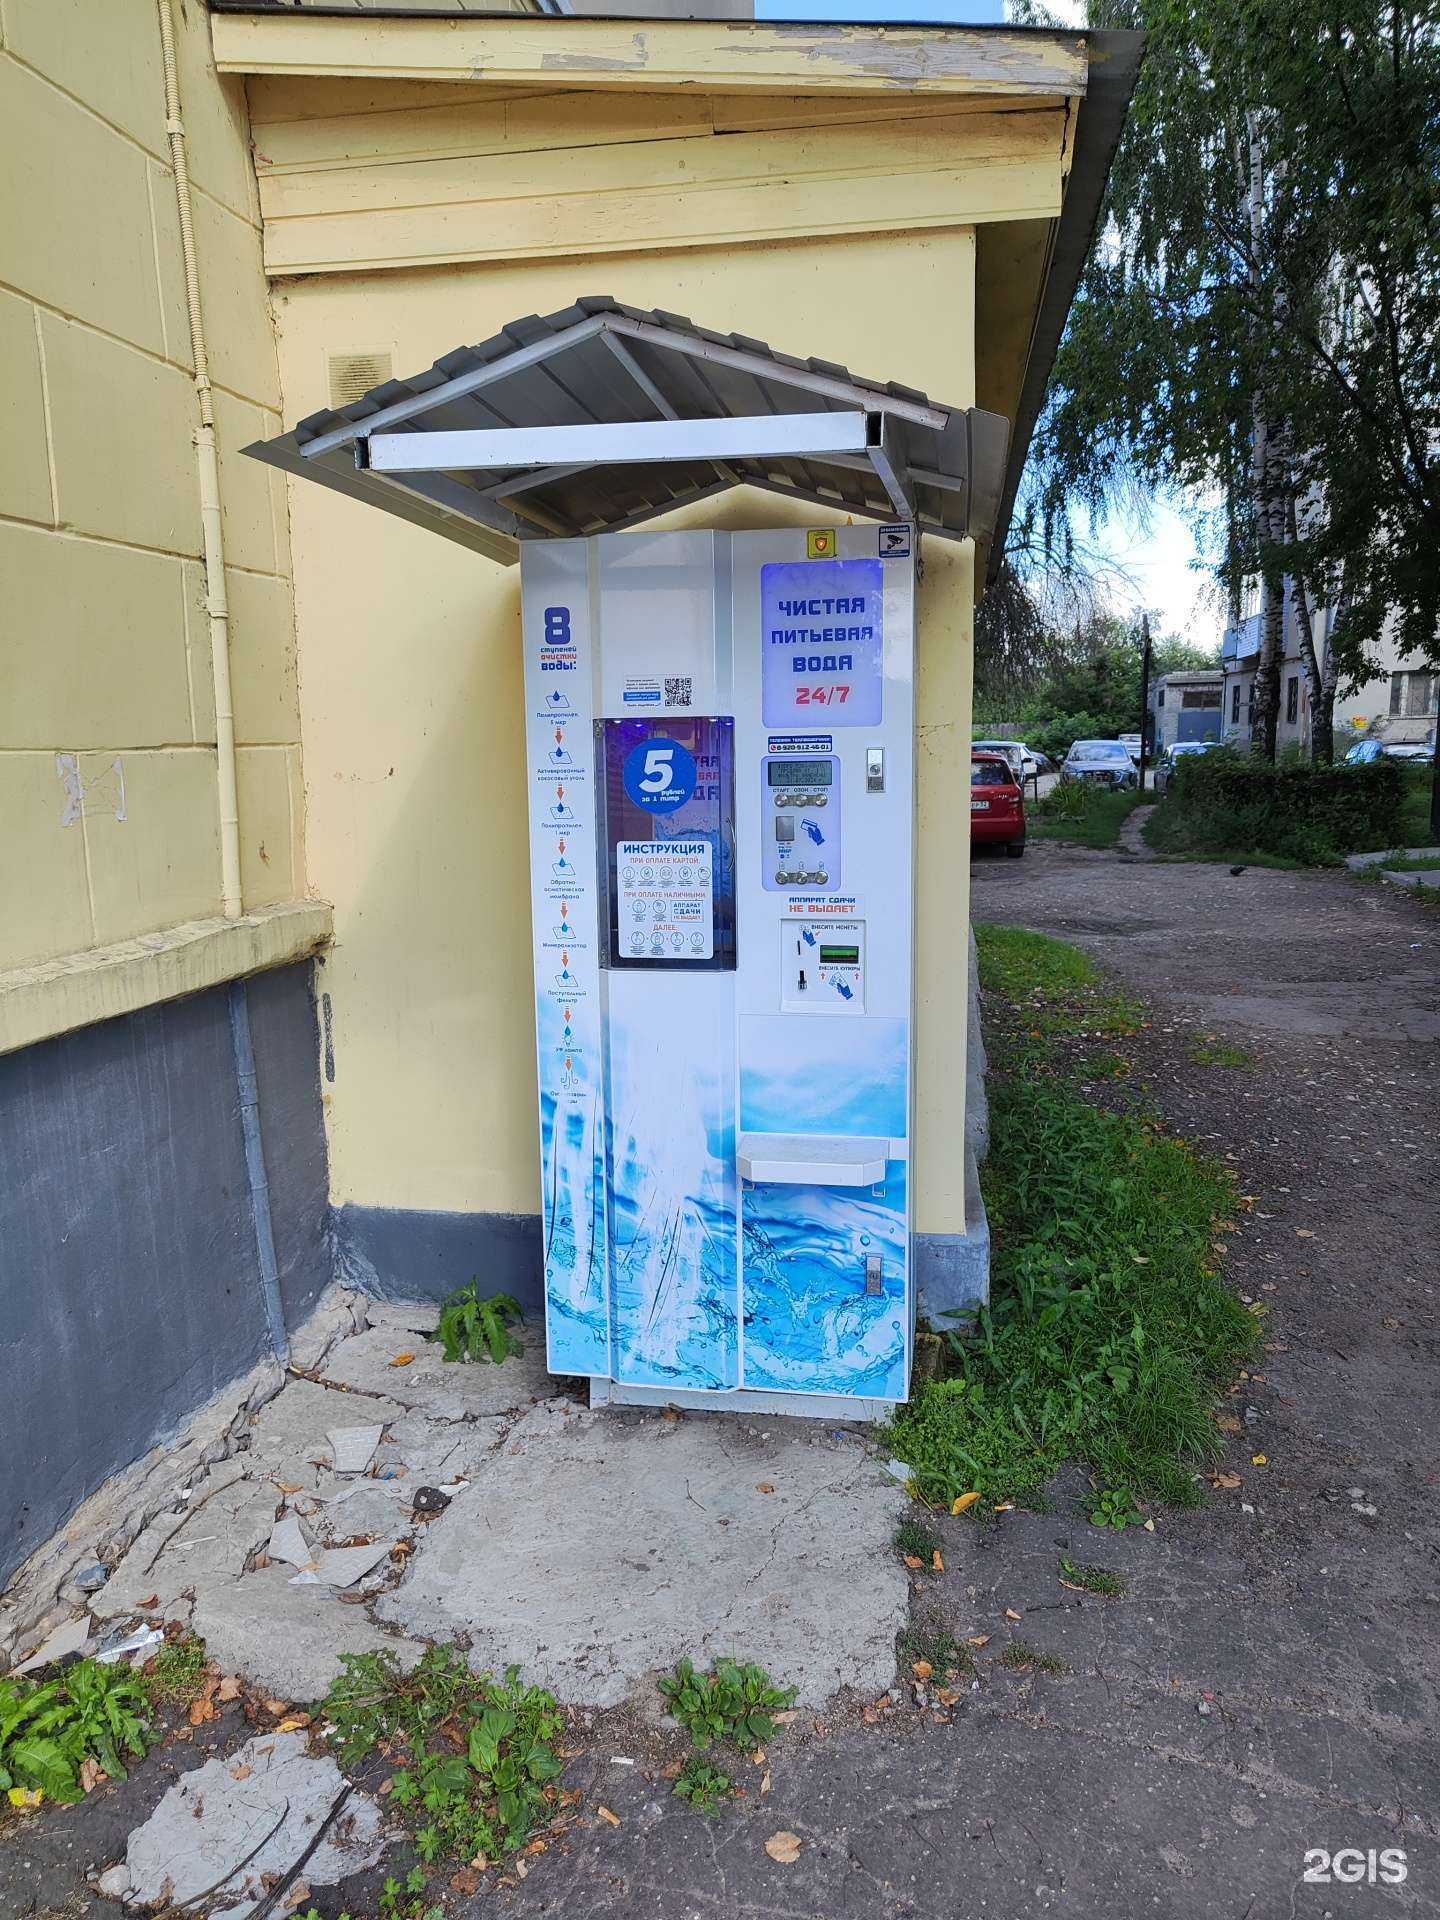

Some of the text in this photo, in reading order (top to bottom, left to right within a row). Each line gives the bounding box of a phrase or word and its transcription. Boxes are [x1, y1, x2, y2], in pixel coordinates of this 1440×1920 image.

[778, 597, 865, 617] ЧИСТАЯ
[544, 606, 571, 645] 8
[771, 626, 873, 644] ПИТЬЕВАЯ
[540, 645, 577, 653] ступеней
[792, 654, 853, 672] ВОДА
[795, 686, 850, 705] 24/7
[638, 749, 674, 792] 5
[623, 844, 705, 855] ИНСТРУКЦИЯ
[789, 905, 856, 913] НЕ ВЫДАЕТ
